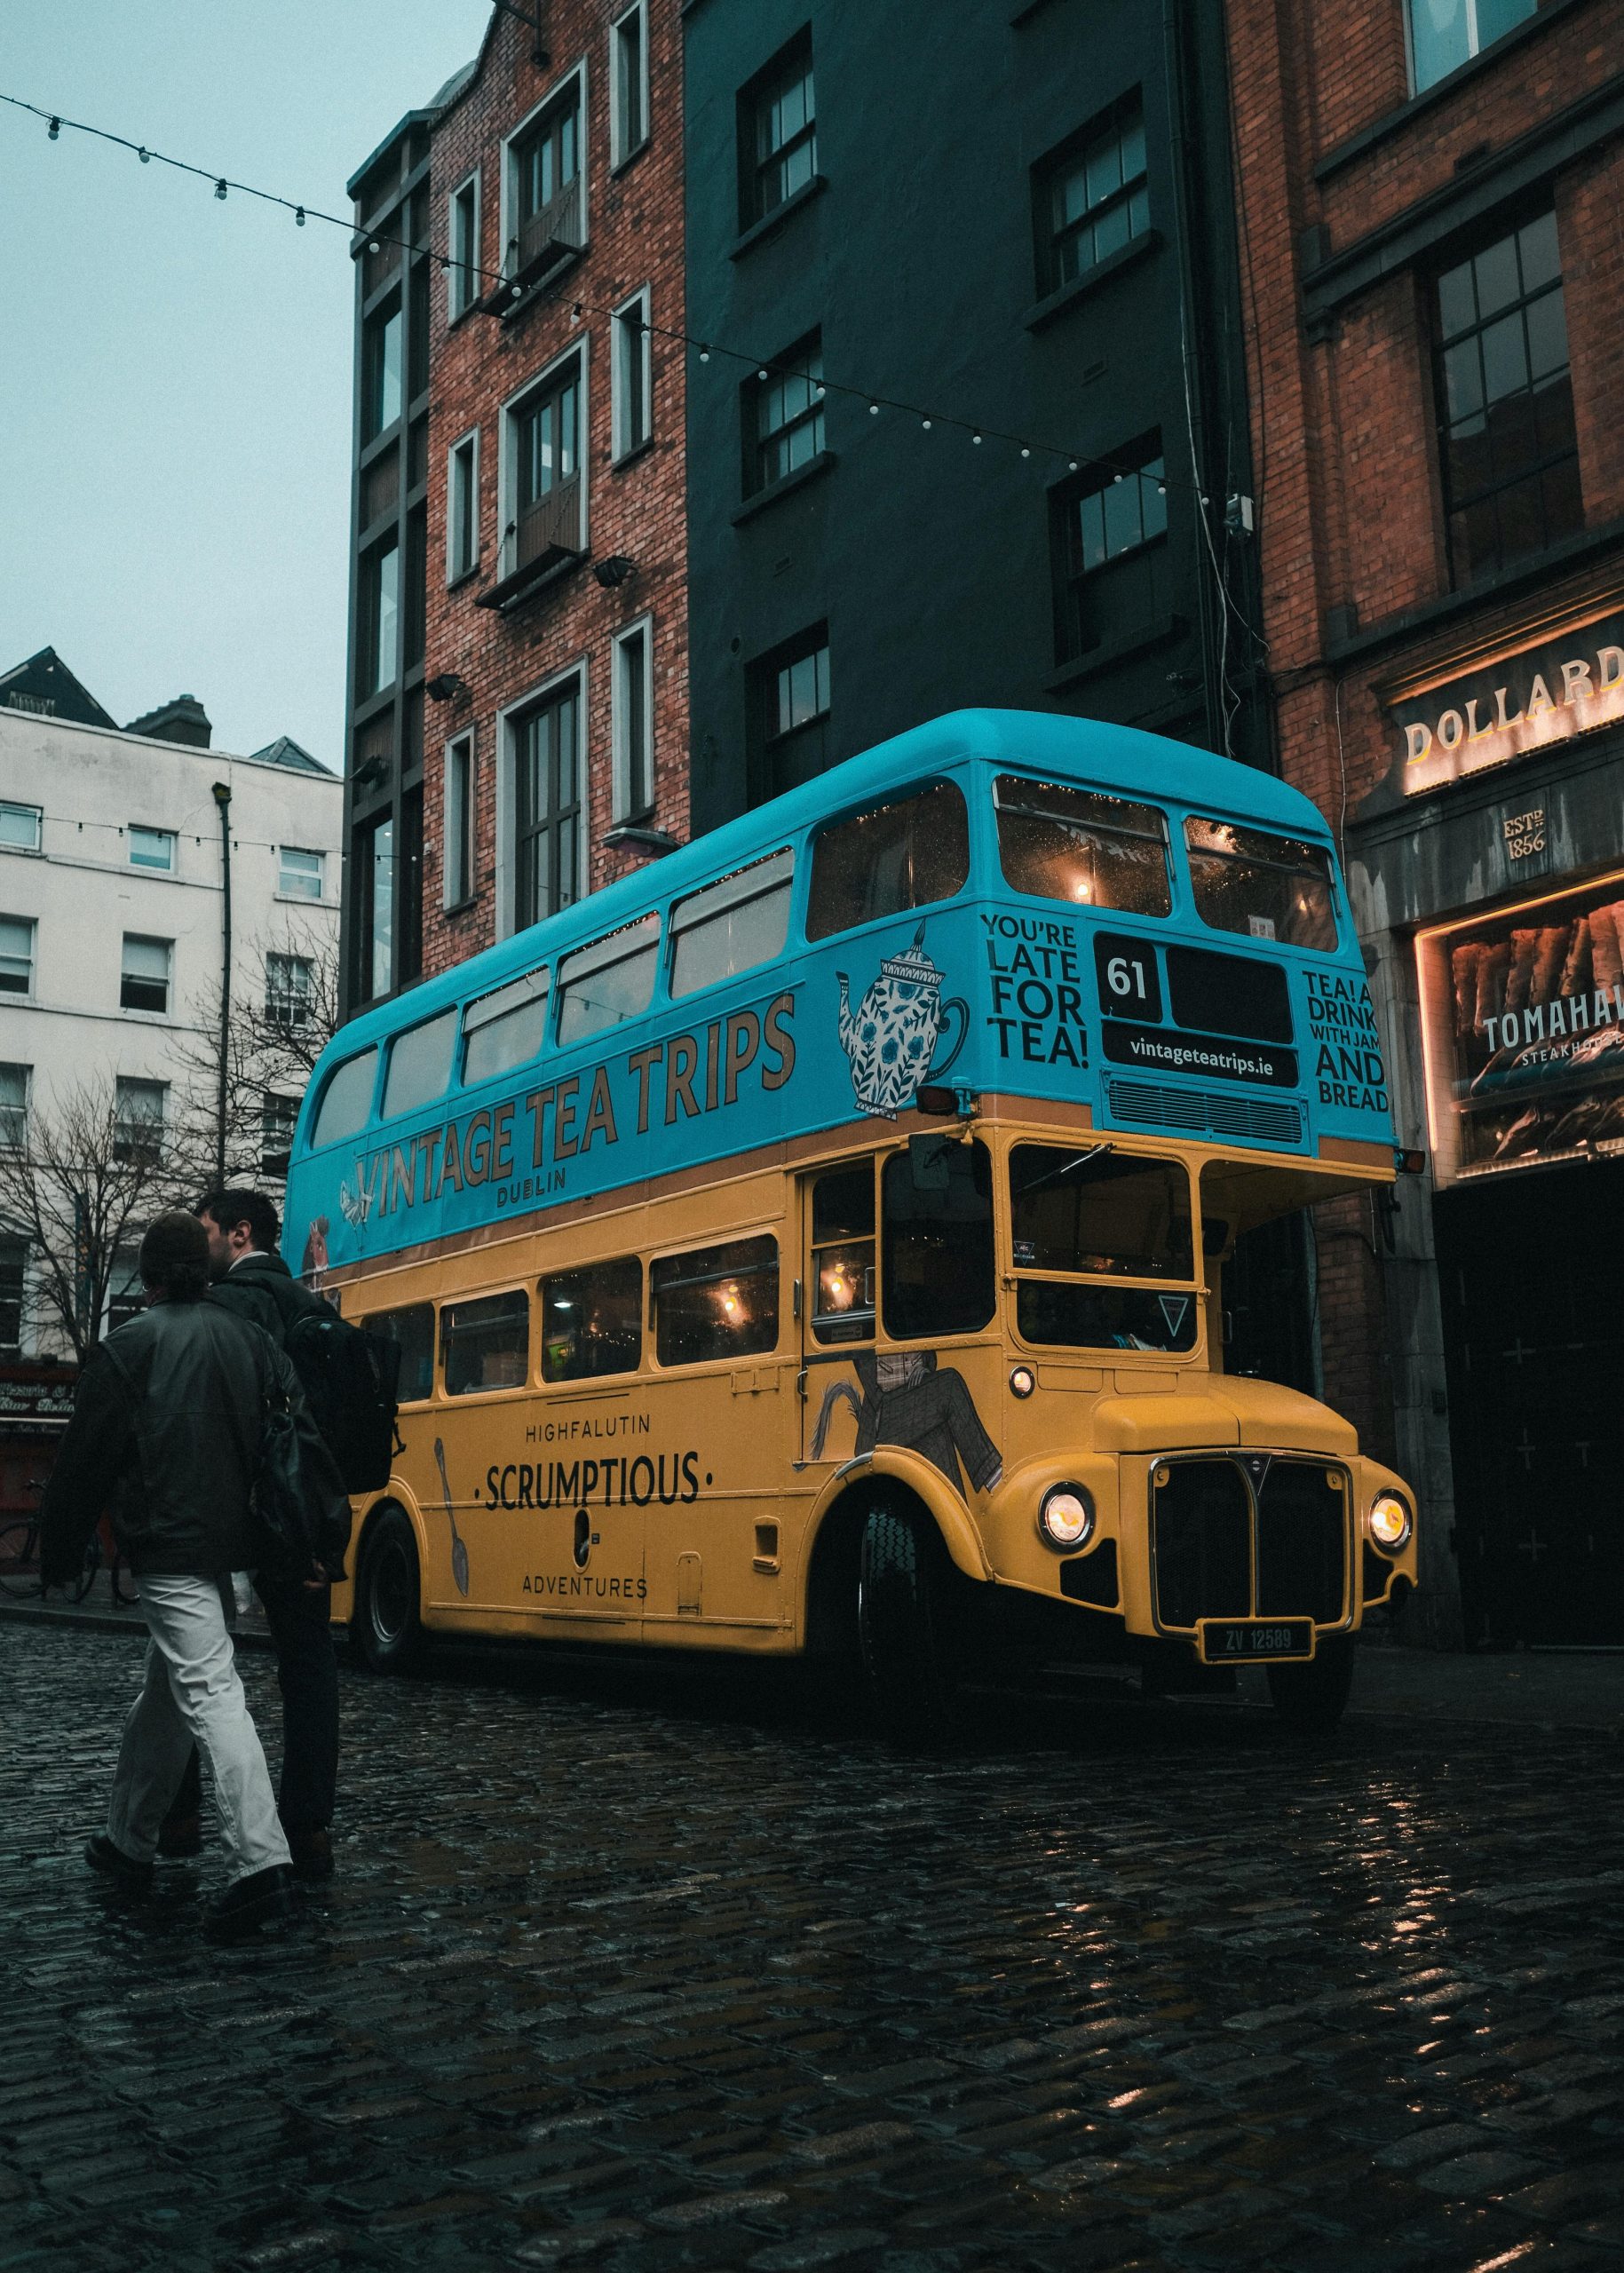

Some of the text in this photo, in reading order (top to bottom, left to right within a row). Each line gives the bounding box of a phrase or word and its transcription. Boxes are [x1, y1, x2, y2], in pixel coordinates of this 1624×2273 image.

[1405, 645, 1624, 765] DOLLARD
[1509, 830, 1546, 859] 1856
[979, 914, 1076, 948] YOU'RE
[986, 939, 1081, 984] LATE
[1107, 957, 1146, 1000] 61
[990, 976, 1083, 1026] FOR
[1302, 970, 1373, 1007] TEA! A
[1307, 996, 1378, 1033] DRINK
[986, 1017, 1089, 1070] TEA!
[1310, 1023, 1351, 1045] WITH
[1522, 1034, 1623, 1066] STEAKHOUSE
[1130, 1037, 1273, 1076] vintageteatrips.ie
[1316, 1044, 1385, 1086] AND
[354, 993, 796, 1219] VINTAGE TEA TRIPS
[1319, 1080, 1390, 1113] BREAD
[496, 1168, 566, 1208] DUBLIN
[526, 1414, 650, 1443] HIGHFALUTIN
[486, 1451, 700, 1510] SCRUMPTIOUS
[522, 1575, 648, 1599] ADVENTURES
[1225, 1628, 1292, 1650] ZV 12589
